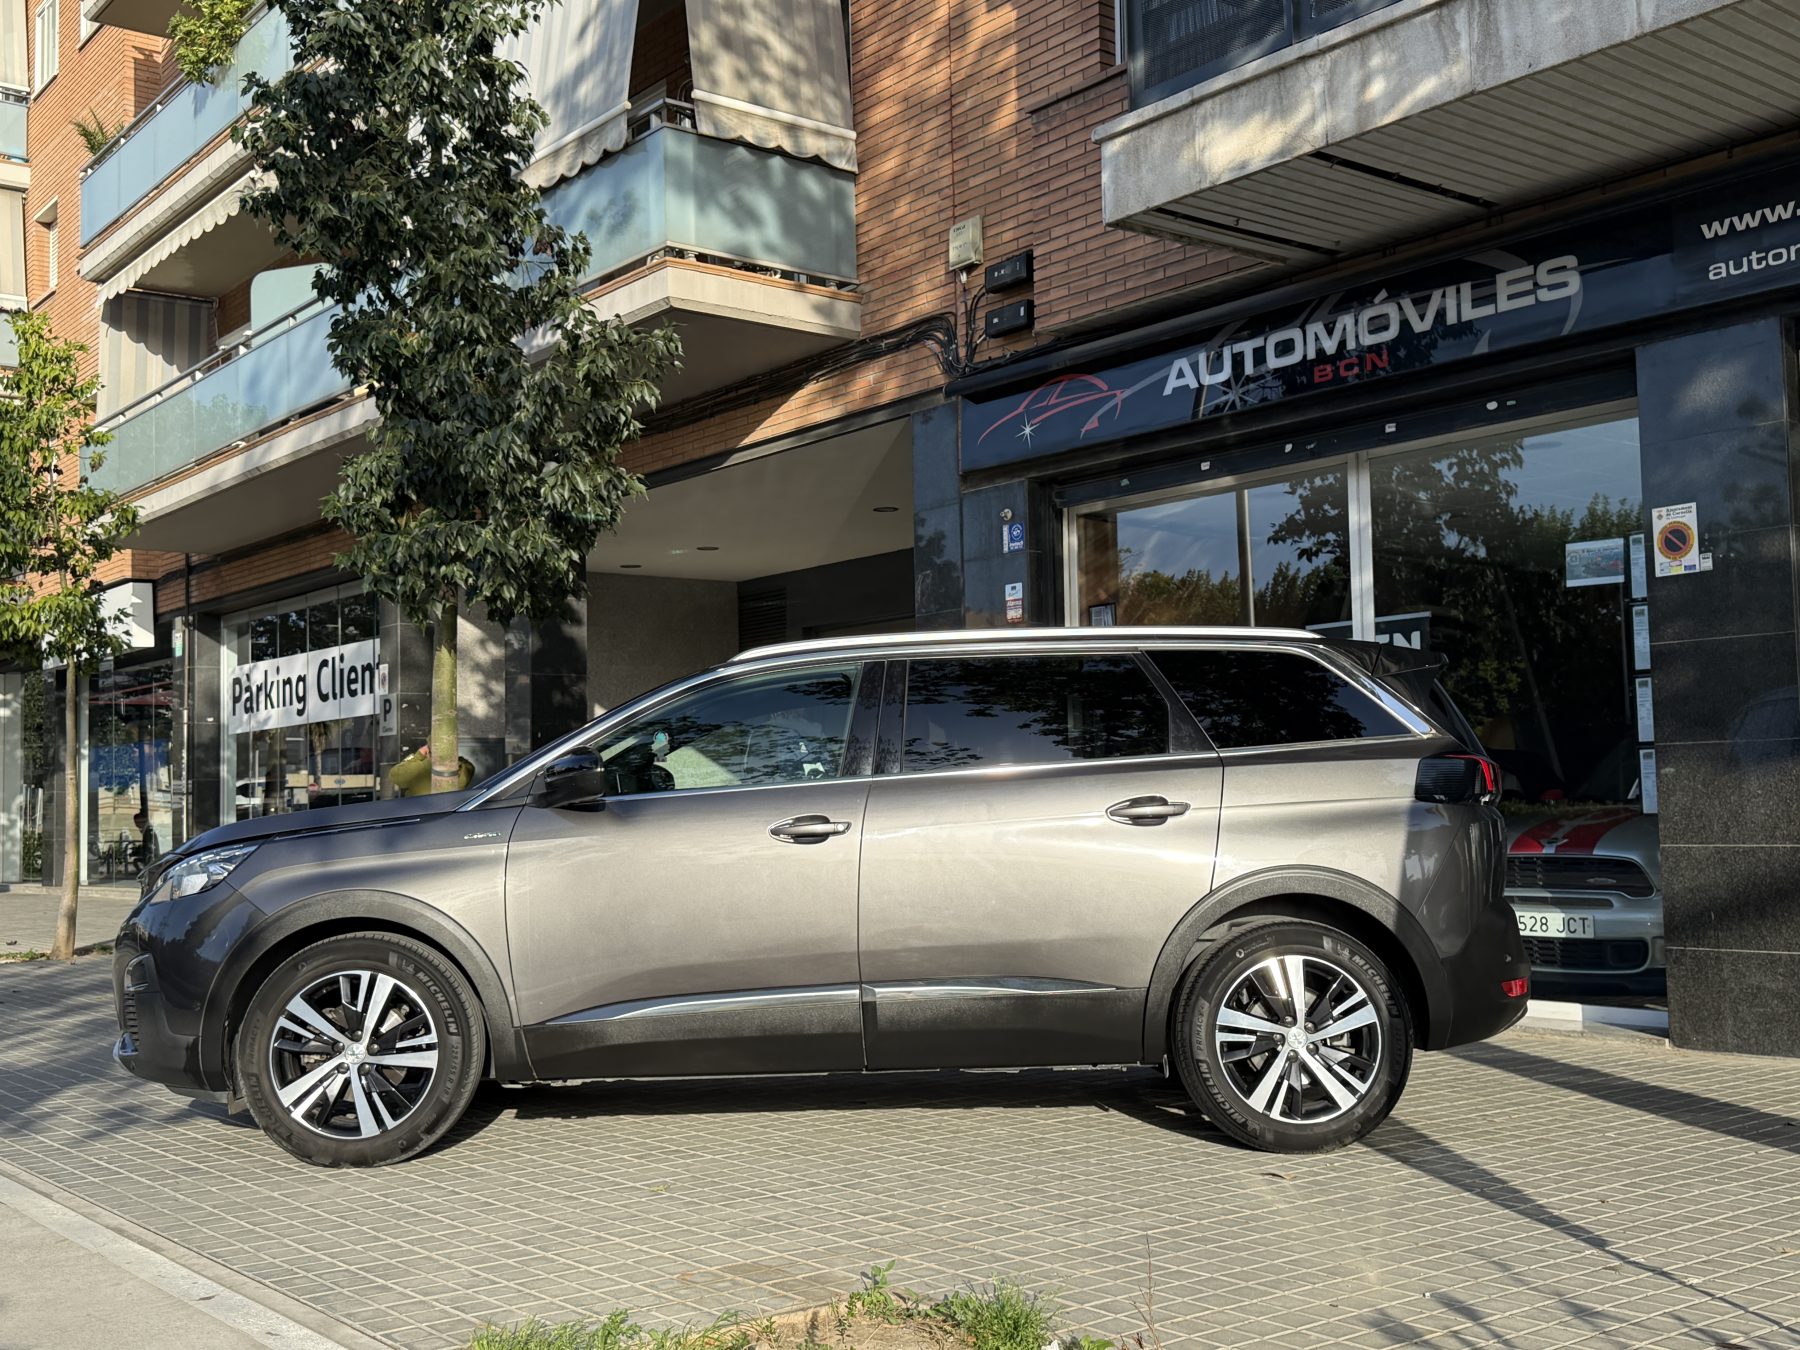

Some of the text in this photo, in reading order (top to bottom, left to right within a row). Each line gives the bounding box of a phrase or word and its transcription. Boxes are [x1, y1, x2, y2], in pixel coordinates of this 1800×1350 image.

[1163, 254, 1581, 396] AUTOMÓVILES
[1313, 350, 1389, 383] BCN
[232, 666, 307, 717] Pàrking
[383, 698, 392, 722] P
[1519, 915, 1589, 934] 528 JCT
[415, 971, 458, 1033] MICHELIN
[1352, 954, 1399, 1015] MICHELIN
[1199, 1062, 1246, 1124] MICHELIN
